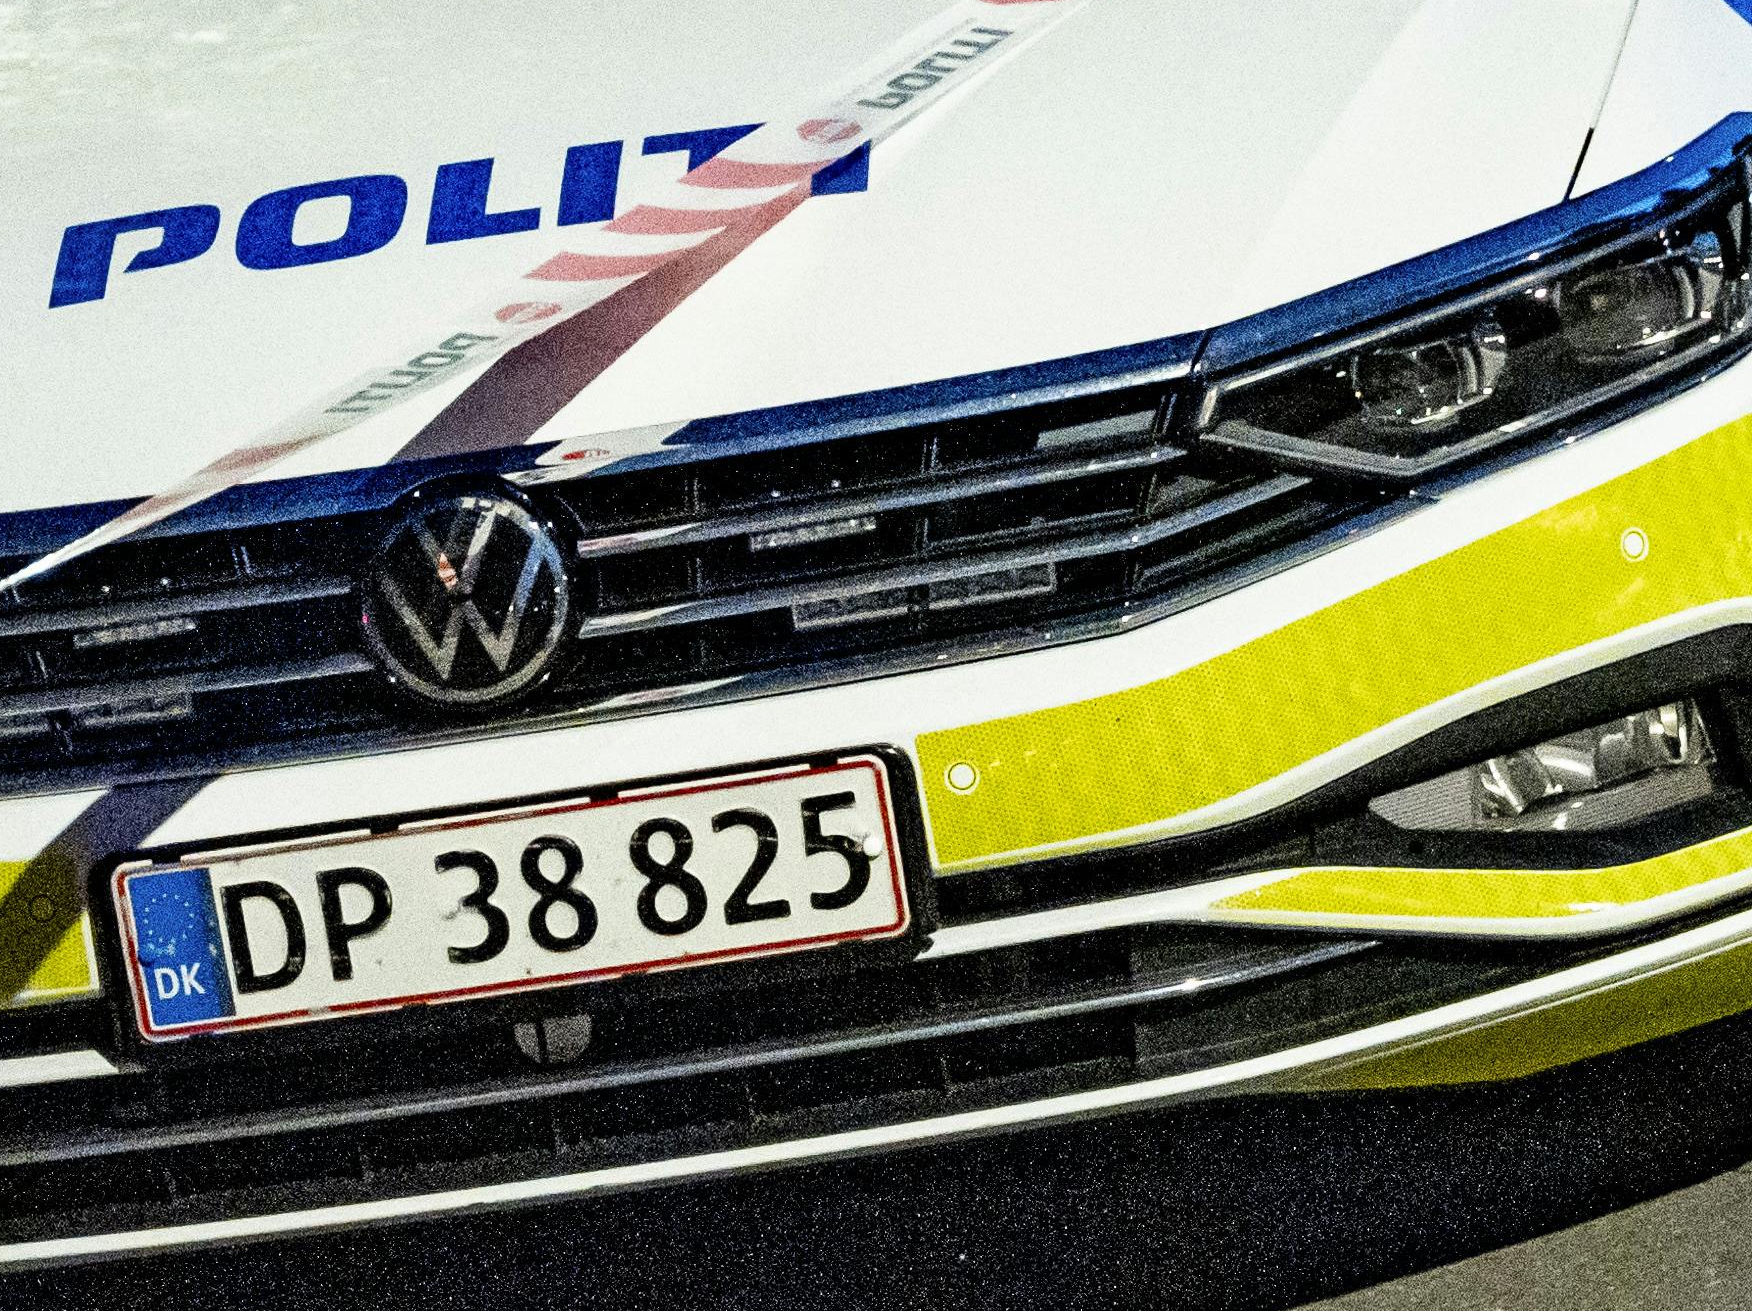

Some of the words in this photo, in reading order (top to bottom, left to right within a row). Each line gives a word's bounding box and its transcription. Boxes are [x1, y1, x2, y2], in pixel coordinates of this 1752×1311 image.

[221, 867, 393, 995] DP
[435, 836, 598, 966] 38
[628, 791, 876, 936] 825
[154, 962, 205, 1000] DK
